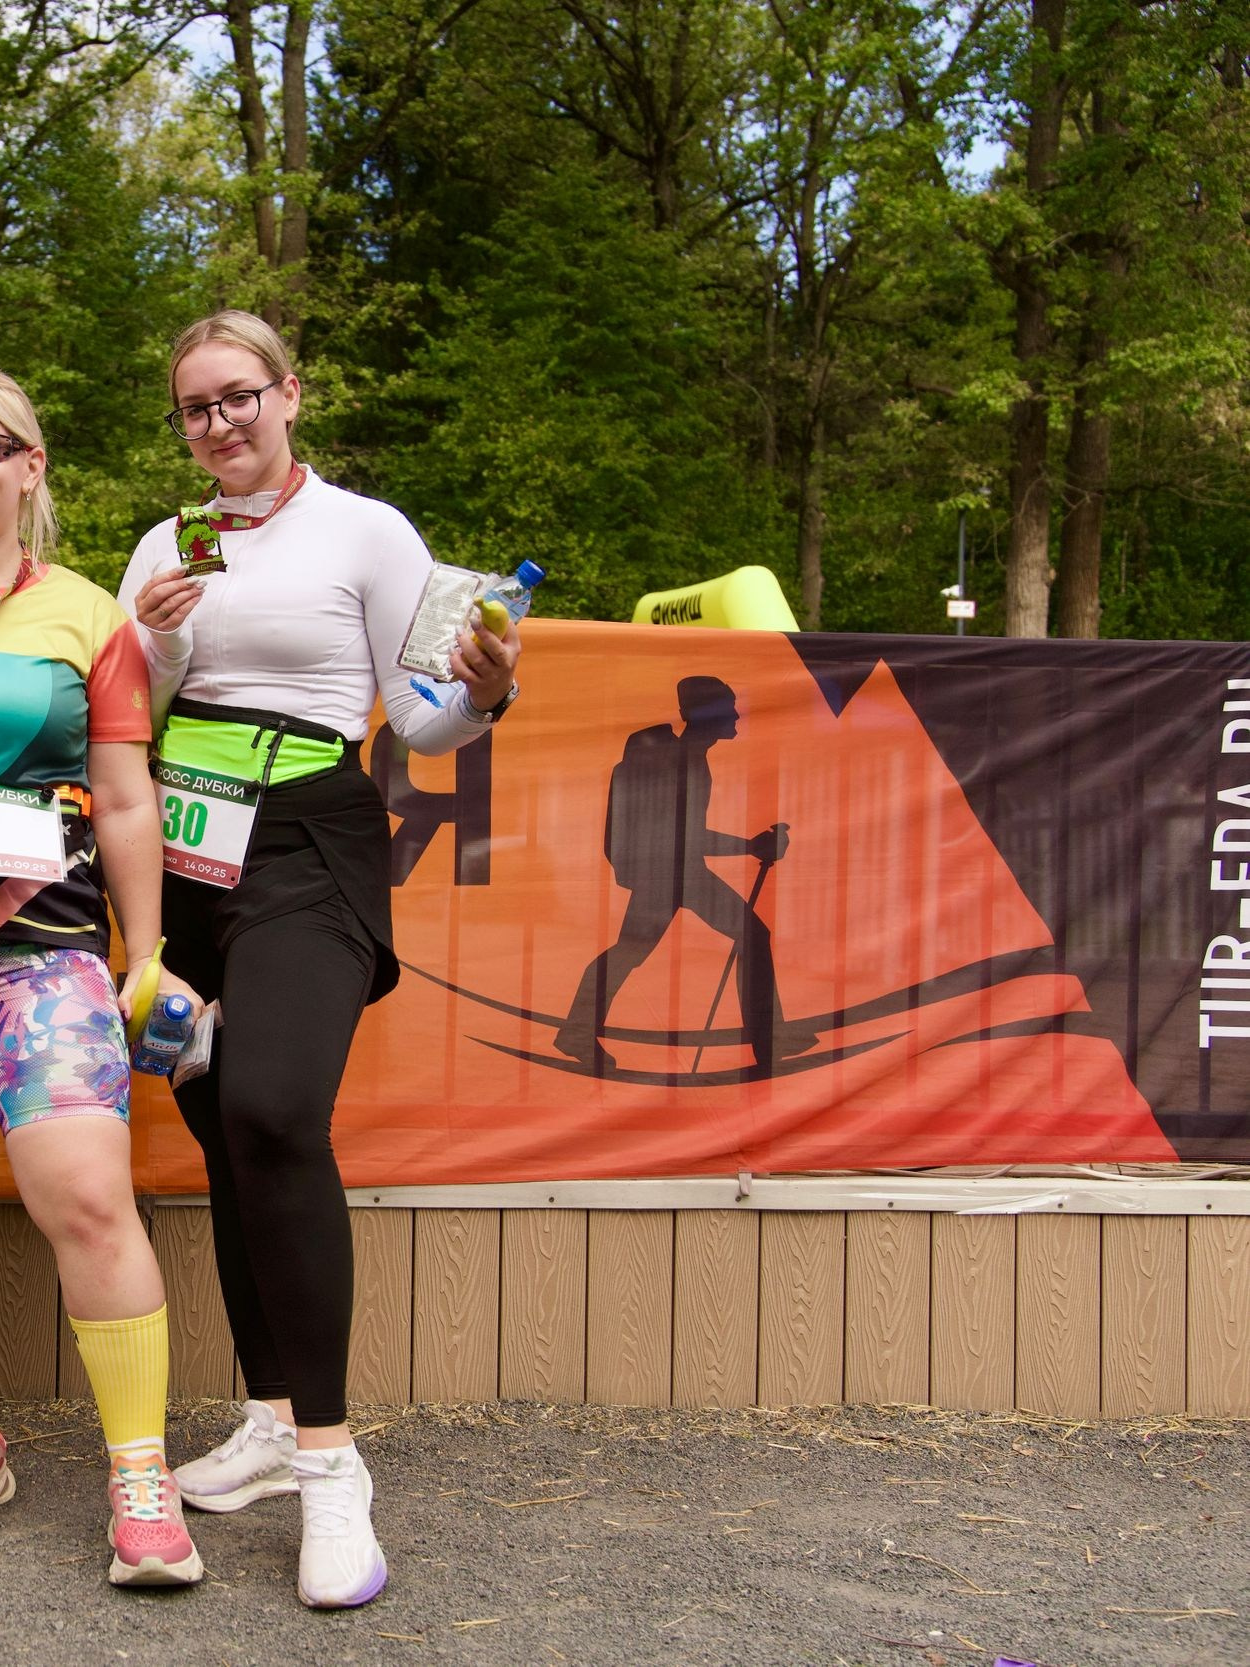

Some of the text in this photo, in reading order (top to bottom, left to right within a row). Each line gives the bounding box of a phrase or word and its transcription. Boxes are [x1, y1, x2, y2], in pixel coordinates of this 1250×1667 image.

[651, 593, 702, 625] ФИНИШ
[157, 766, 245, 799] РОСС ДУБКИ
[162, 794, 209, 848] 30
[184, 859, 228, 879] 14.09.25
